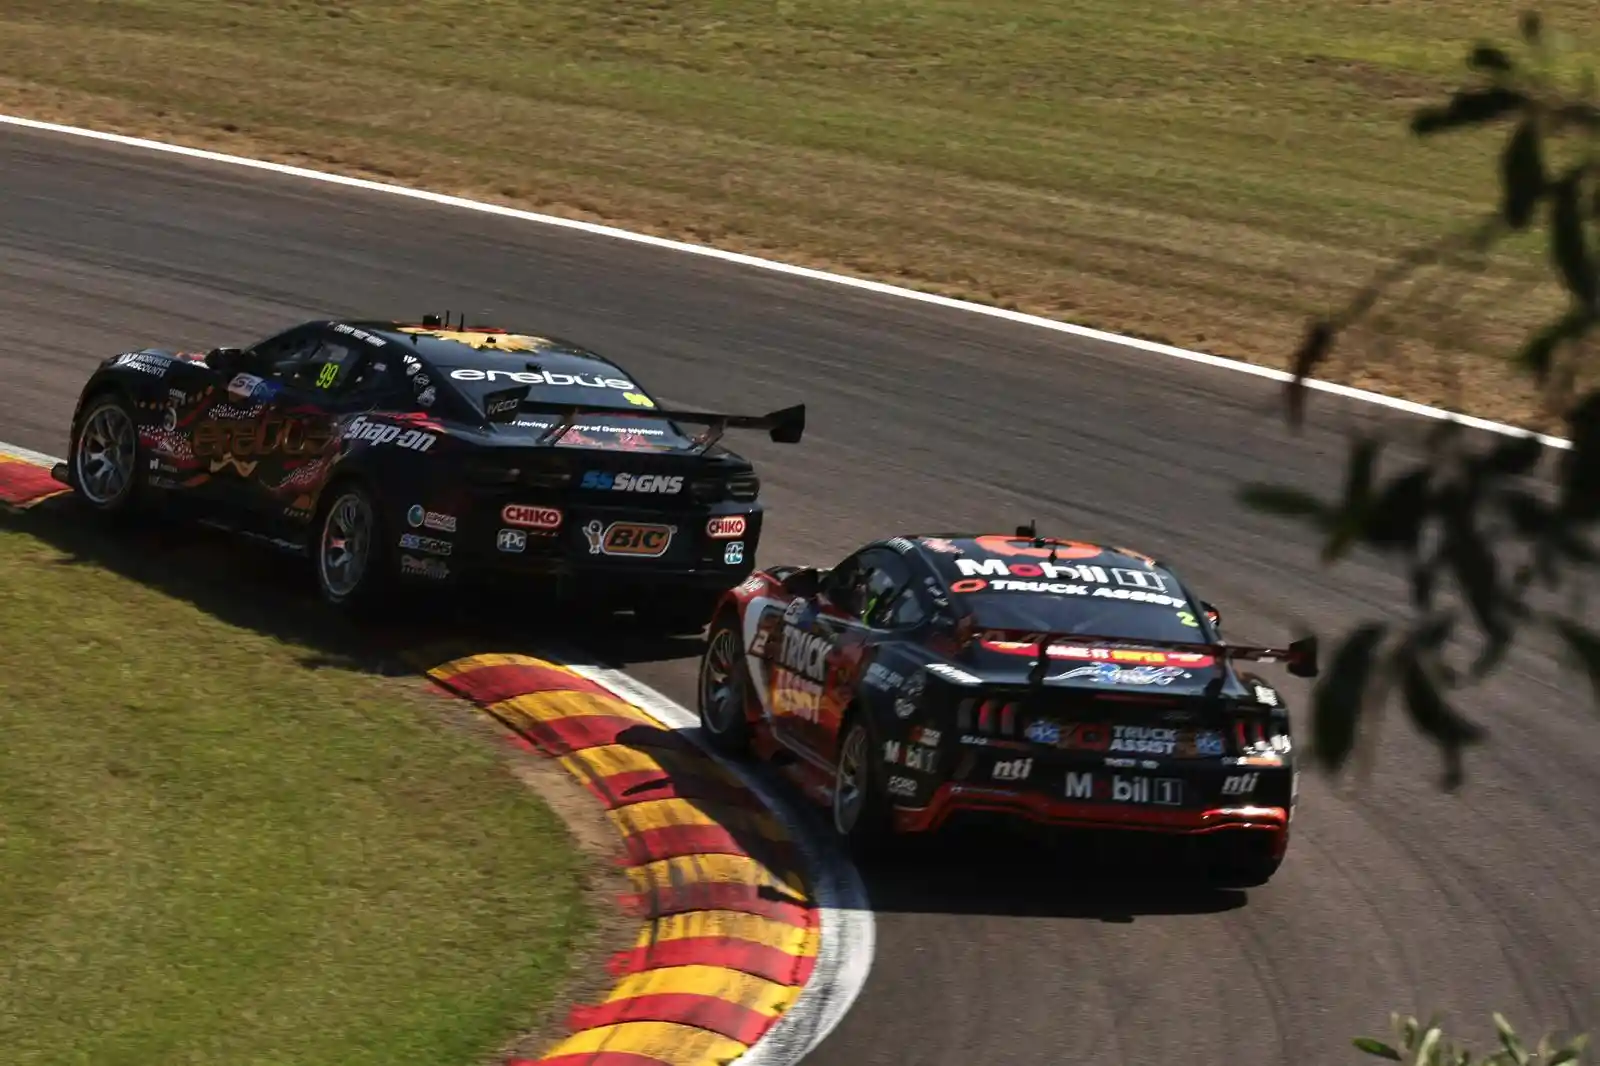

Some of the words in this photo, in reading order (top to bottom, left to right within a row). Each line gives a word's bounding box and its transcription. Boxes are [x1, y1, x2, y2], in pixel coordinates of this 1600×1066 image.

[315, 362, 340, 389] 99
[450, 369, 635, 389] erebus
[486, 398, 519, 415] IVECO
[343, 416, 437, 452] Snap-on
[505, 506, 559, 525] CHIKO
[708, 519, 743, 534] CHIKO
[499, 531, 526, 549] PPG
[954, 558, 1110, 583] Mobil
[990, 580, 1089, 596] TRUCK
[1092, 588, 1187, 609] ASSIST
[1176, 611, 1200, 627] 2
[779, 625, 834, 682] TRUCK
[1112, 725, 1178, 741] TRUCK
[1109, 740, 1177, 755] ASSIST
[1065, 771, 1150, 803] Mobil
